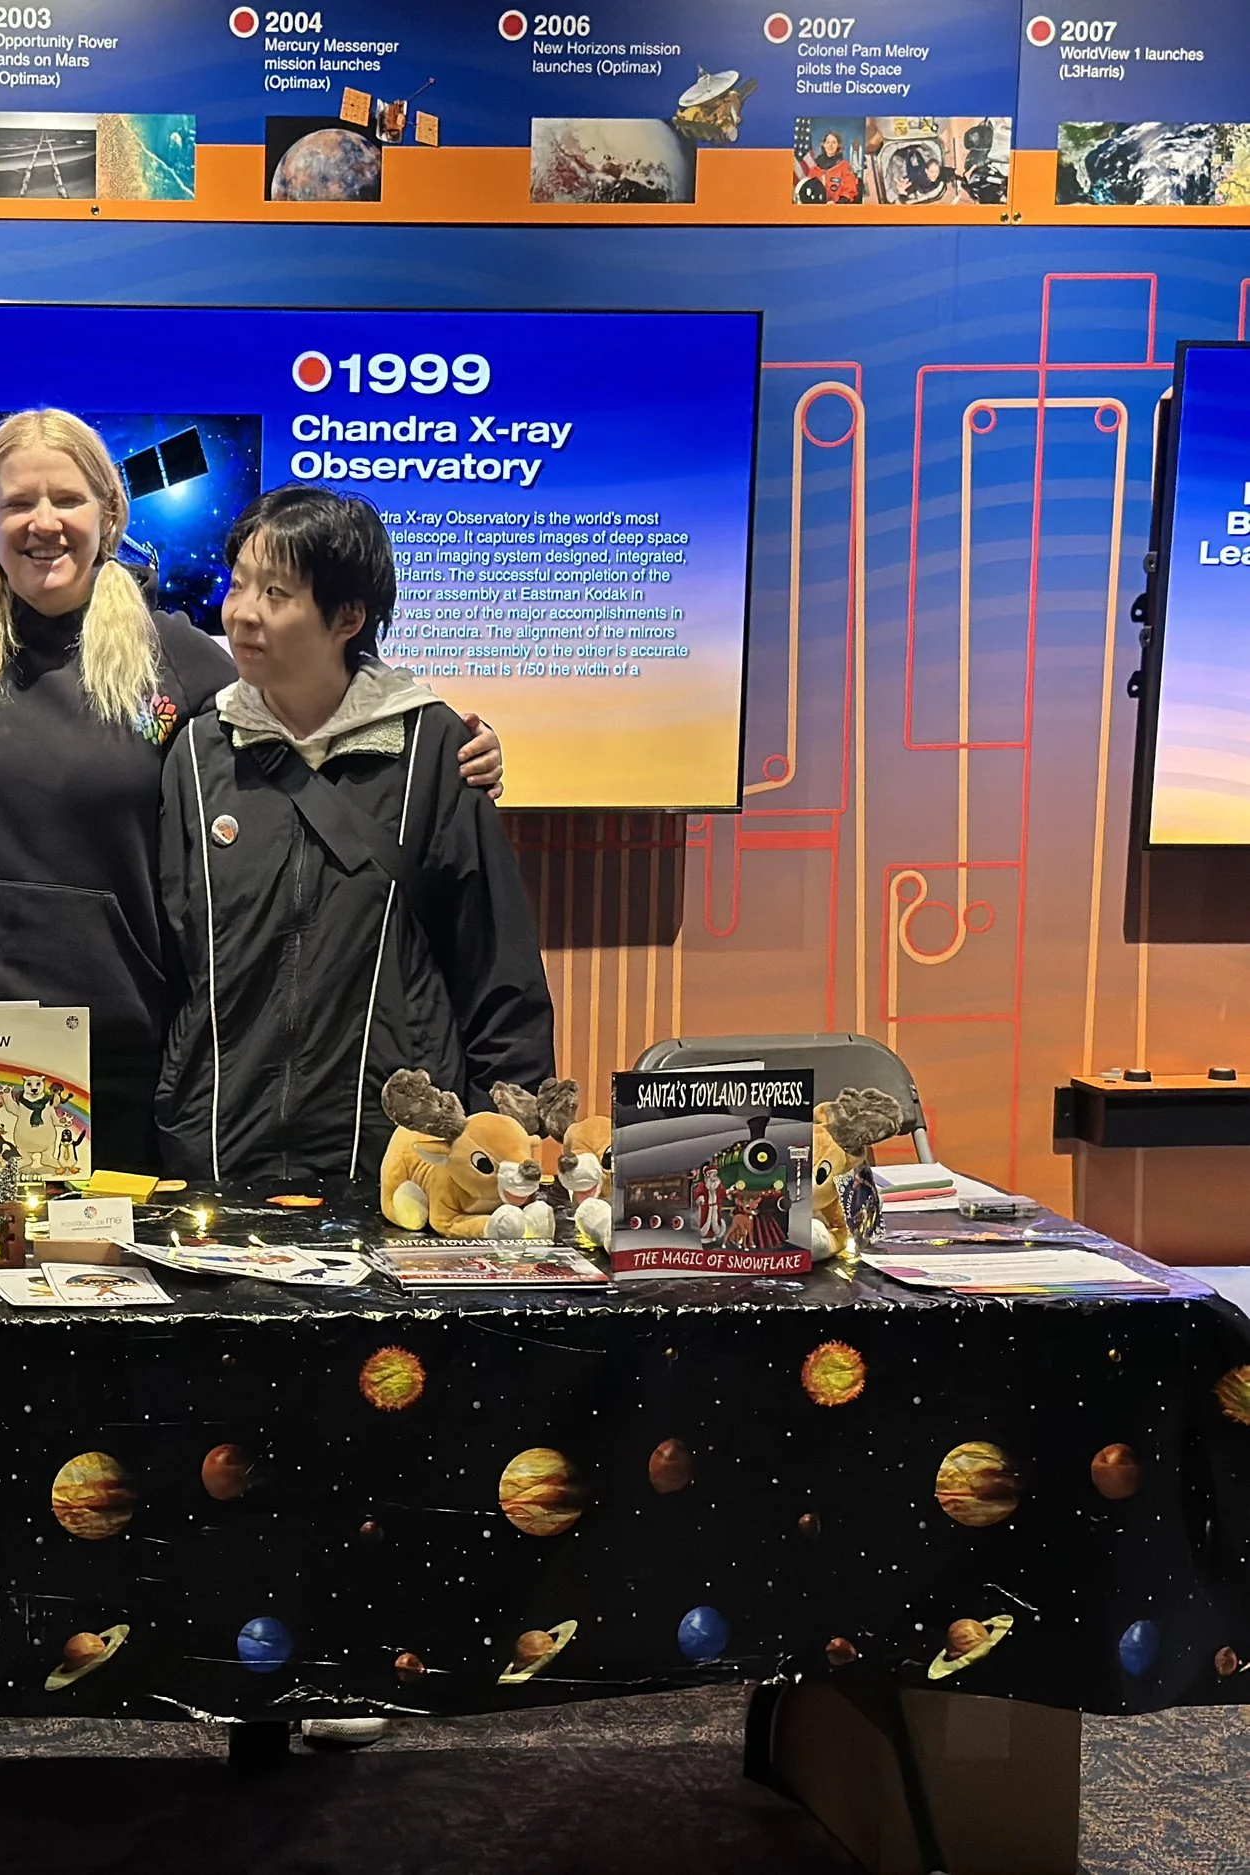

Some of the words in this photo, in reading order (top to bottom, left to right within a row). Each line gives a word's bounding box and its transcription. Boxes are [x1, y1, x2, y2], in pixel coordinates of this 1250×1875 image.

[265, 12, 323, 33] 2004
[533, 15, 591, 36] 2006
[798, 18, 855, 39] 2007
[1060, 21, 1117, 42] 2007
[78, 35, 118, 49] Rover
[265, 38, 320, 54] Mercury
[324, 39, 399, 55] Messenger
[533, 41, 564, 54] New
[567, 42, 626, 55] Horizons
[630, 43, 681, 55] mission
[798, 44, 848, 57] Colonel
[852, 45, 881, 57] Pam
[885, 45, 929, 60] Melroy
[1060, 47, 1130, 60] WorldView
[1135, 48, 1140, 60] 1
[1145, 48, 1204, 61] launches
[34, 55, 51, 66] on
[55, 54, 90, 67] Mars
[264, 58, 316, 70] mission
[320, 58, 381, 71] launches
[532, 61, 593, 73] launches
[597, 61, 661, 76] (Optimax)
[797, 63, 831, 78] pilots
[836, 63, 856, 75] the
[860, 63, 902, 78] Space
[1060, 65, 1124, 80] (L3Harris)
[264, 75, 331, 91] (Optimax)
[796, 81, 842, 94] Shuttle
[846, 81, 910, 97] Discovery
[338, 353, 491, 395] 1999
[292, 414, 457, 442] Chandra
[468, 416, 572, 449] X-ray
[291, 451, 542, 486] Observatory
[406, 511, 442, 528] X-ray
[446, 511, 530, 528] Observatory
[534, 512, 545, 524] is
[549, 512, 571, 525] the
[575, 512, 622, 525] world's
[626, 513, 659, 525] most
[391, 531, 460, 546] telescope.
[465, 530, 472, 543] It
[477, 531, 536, 546] captures
[539, 531, 589, 546] images
[592, 531, 606, 544] of
[610, 531, 643, 546] deep
[648, 533, 688, 547] space
[415, 552, 432, 562] an
[437, 549, 490, 565] imaging
[494, 551, 541, 565] system
[546, 549, 611, 565] designed,
[616, 549, 686, 565] integrated,
[449, 568, 475, 581] The
[479, 568, 550, 581] successful
[554, 568, 628, 584] completion
[632, 568, 646, 581] of
[650, 568, 670, 582] the
[435, 588, 499, 603] assembly
[503, 588, 516, 600] at
[521, 588, 580, 600] Eastman
[585, 588, 627, 600] Kodak
[631, 588, 643, 600] in
[404, 609, 431, 619] was
[435, 609, 461, 619] one
[465, 606, 479, 619] of
[482, 607, 503, 619] the
[508, 607, 546, 622] major
[550, 606, 666, 622] accomplishments
[671, 606, 683, 619] in
[403, 625, 416, 638] of
[420, 625, 482, 638] Chandra.
[486, 625, 512, 638] The
[513, 625, 582, 641] alignment
[586, 625, 600, 638] of
[603, 625, 624, 638] the
[628, 625, 675, 638] mirrors
[382, 644, 395, 657] of
[398, 644, 419, 657] the
[423, 644, 463, 657] mirror
[467, 644, 530, 659] assembly
[535, 645, 547, 657] to
[551, 644, 572, 657] the
[576, 644, 612, 657] other
[615, 644, 627, 657] is
[630, 645, 688, 657] accurate
[430, 663, 462, 676] inch.
[517, 663, 544, 676] 1/50
[549, 663, 570, 675] the
[574, 663, 609, 676] width
[690, 1081, 747, 1108] TOYLAND
[442, 1239, 498, 1247] TOYLAND
[634, 1252, 659, 1267] THE
[661, 1251, 703, 1265] MAGIC
[707, 1254, 725, 1266] OF
[727, 1255, 801, 1271] SNOWFLAKE
